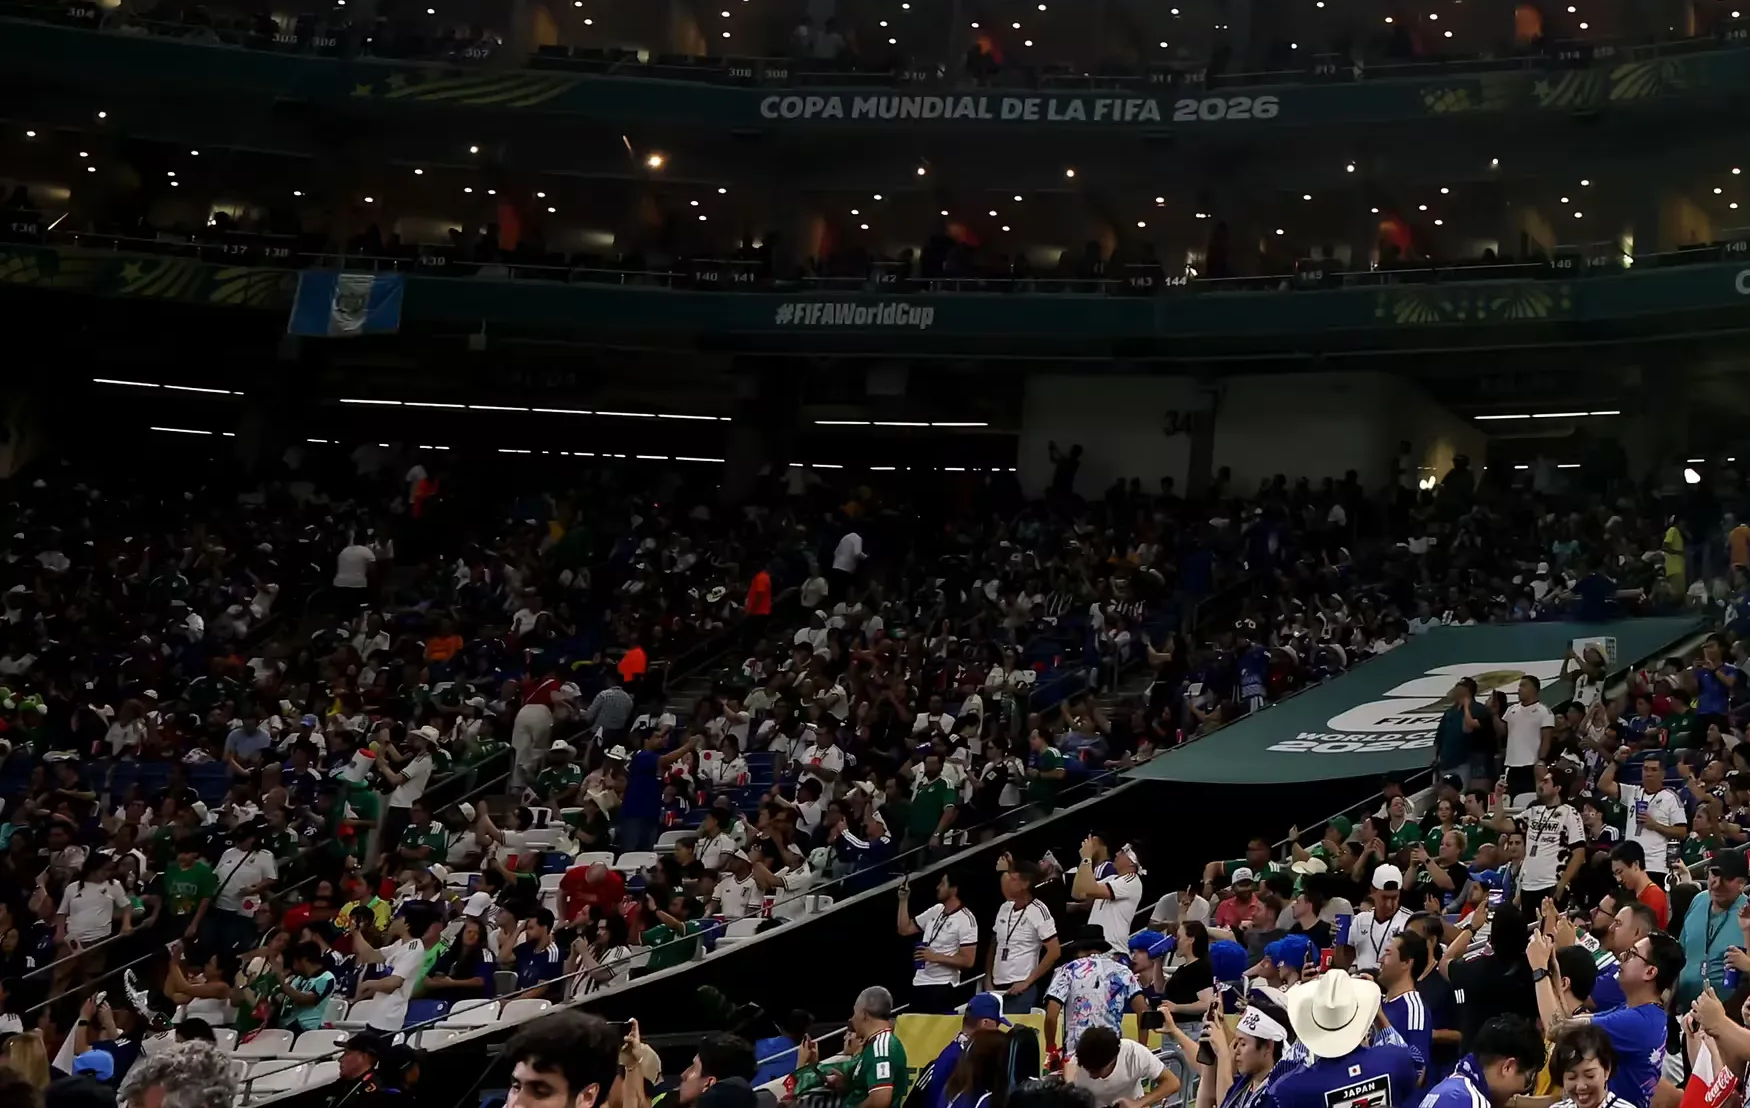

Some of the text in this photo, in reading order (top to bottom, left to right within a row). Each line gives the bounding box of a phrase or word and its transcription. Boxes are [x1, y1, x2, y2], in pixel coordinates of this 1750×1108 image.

[760, 95, 1280, 122] COPA MUNDIAL DE LA FIFA 2026
[734, 273, 755, 283] 141
[1165, 276, 1187, 286] 144
[775, 302, 935, 330] #FIFAWorldCup
[1163, 410, 1192, 435] 34
[1296, 732, 1403, 742] WORLD
[1265, 740, 1435, 754] 2026
[1342, 1081, 1376, 1098] JAPAN
